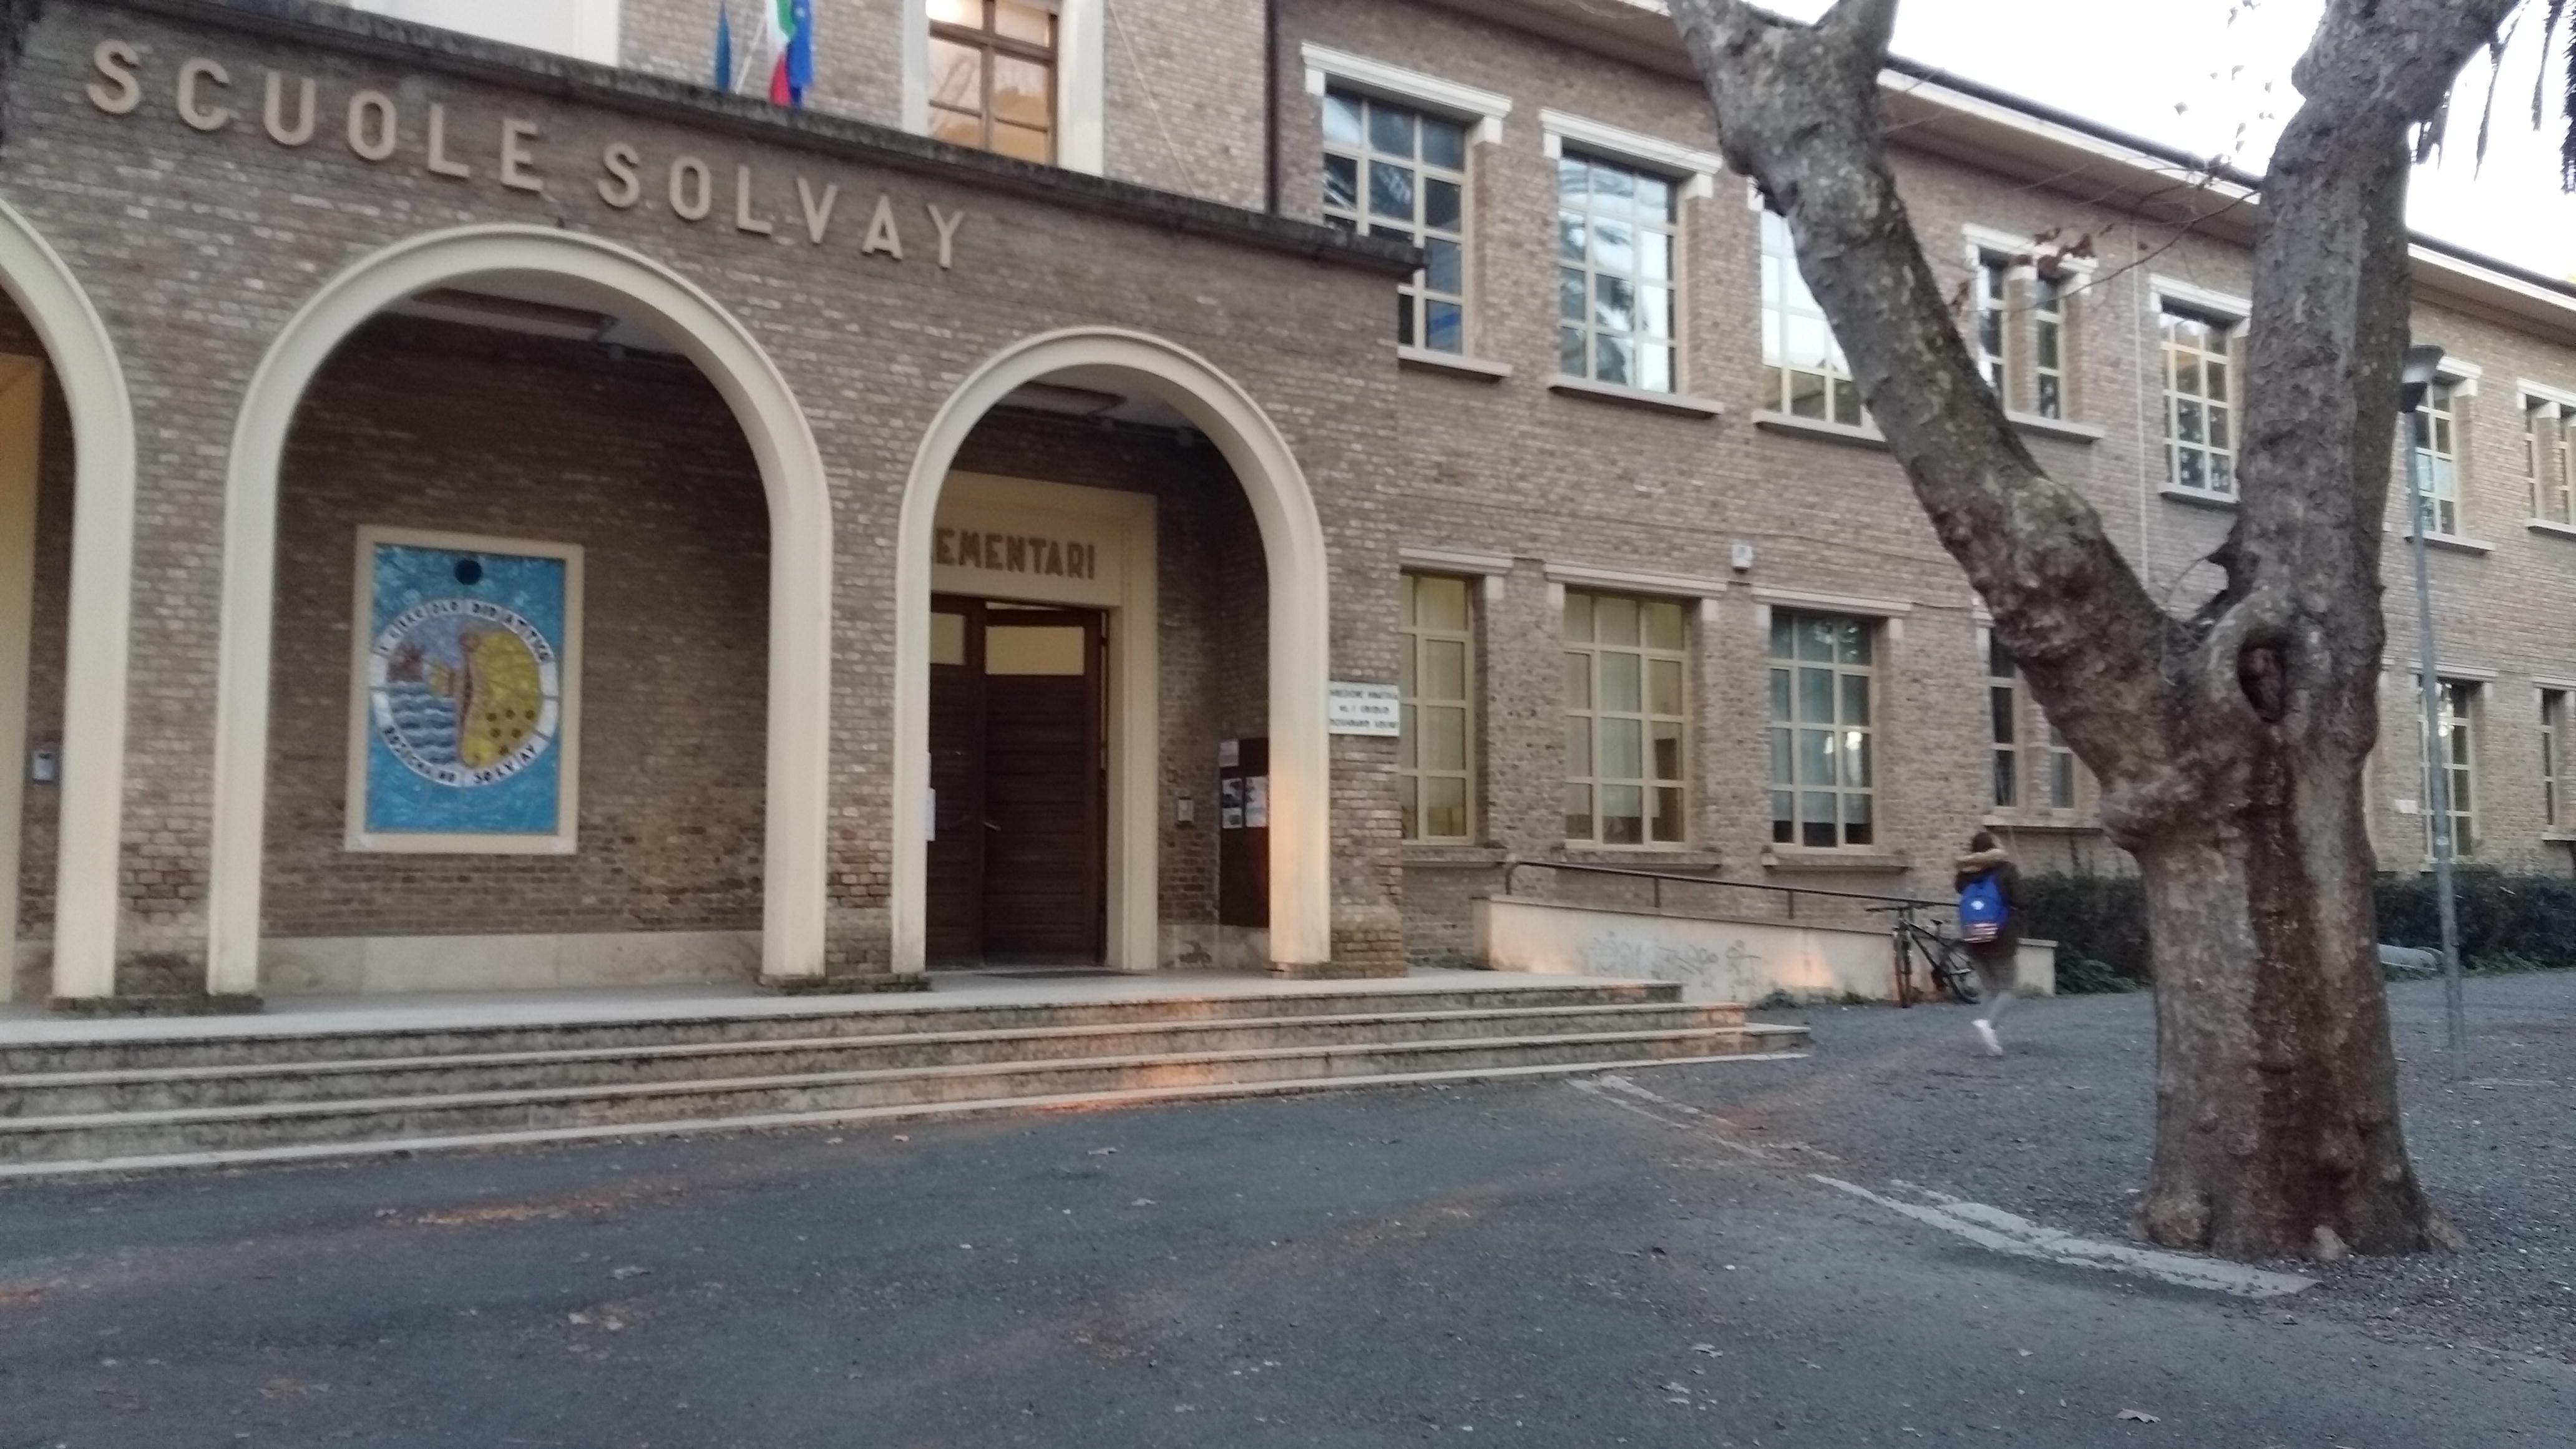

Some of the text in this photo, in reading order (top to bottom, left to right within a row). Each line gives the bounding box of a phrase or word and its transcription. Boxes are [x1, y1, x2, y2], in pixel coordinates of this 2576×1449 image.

[86, 38, 964, 269] SCUOLE SOLVAY
[932, 527, 1096, 580] EMENTARI
